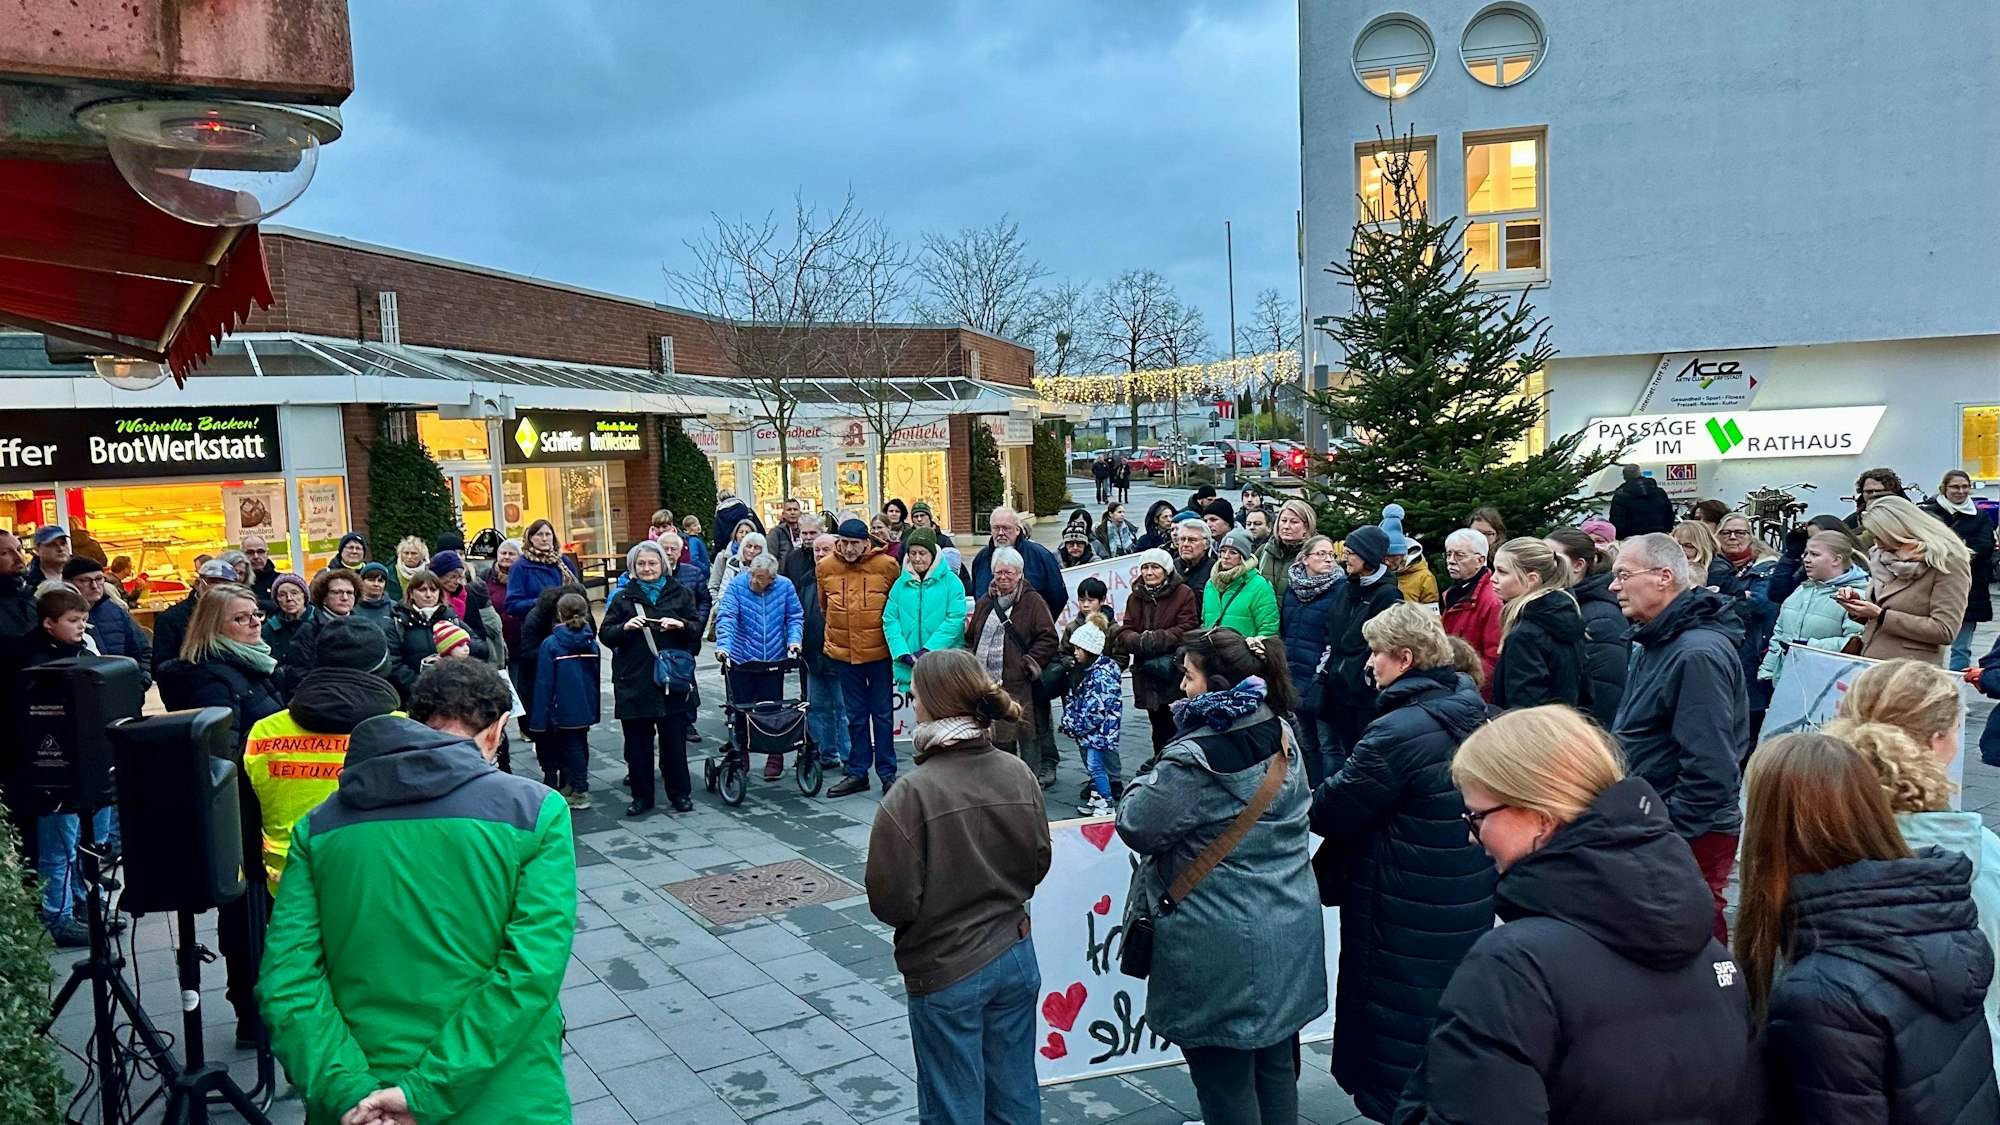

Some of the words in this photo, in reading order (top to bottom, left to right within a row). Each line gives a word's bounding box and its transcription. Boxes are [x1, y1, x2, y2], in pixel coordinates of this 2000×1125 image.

[756, 426, 821, 439] Gesndheit
[891, 423, 946, 444] potheke
[1599, 420, 1697, 439] PASSAGE
[89, 432, 265, 464] BrotWerkstatt
[540, 430, 584, 453] Schiffer
[1656, 440, 1682, 455] IM
[1748, 433, 1852, 452] RATHAUS
[1668, 464, 1696, 479] Köhl
